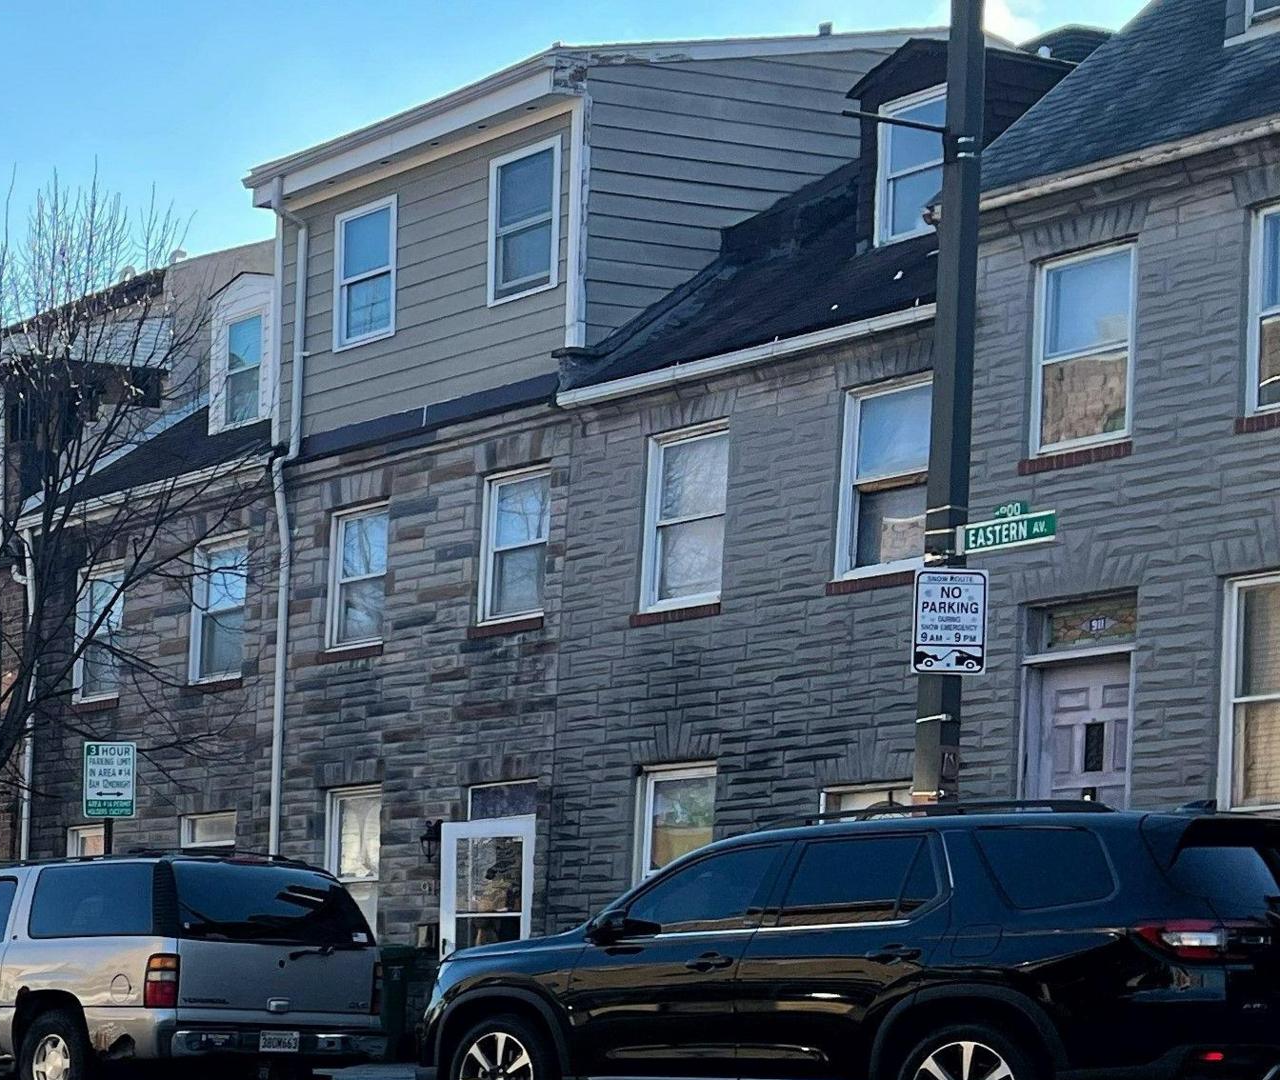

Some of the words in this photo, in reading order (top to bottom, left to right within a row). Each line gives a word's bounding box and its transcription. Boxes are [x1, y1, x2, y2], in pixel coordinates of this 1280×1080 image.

[968, 521, 1028, 549] EASTERN
[1032, 520, 1047, 535] AV.
[940, 586, 962, 599] NO
[921, 601, 979, 614] PARKING
[921, 632, 928, 642] 9
[954, 633, 961, 642] 9
[90, 746, 97, 755] 3
[101, 747, 131, 756] HOUR
[98, 768, 116, 777] AREA
